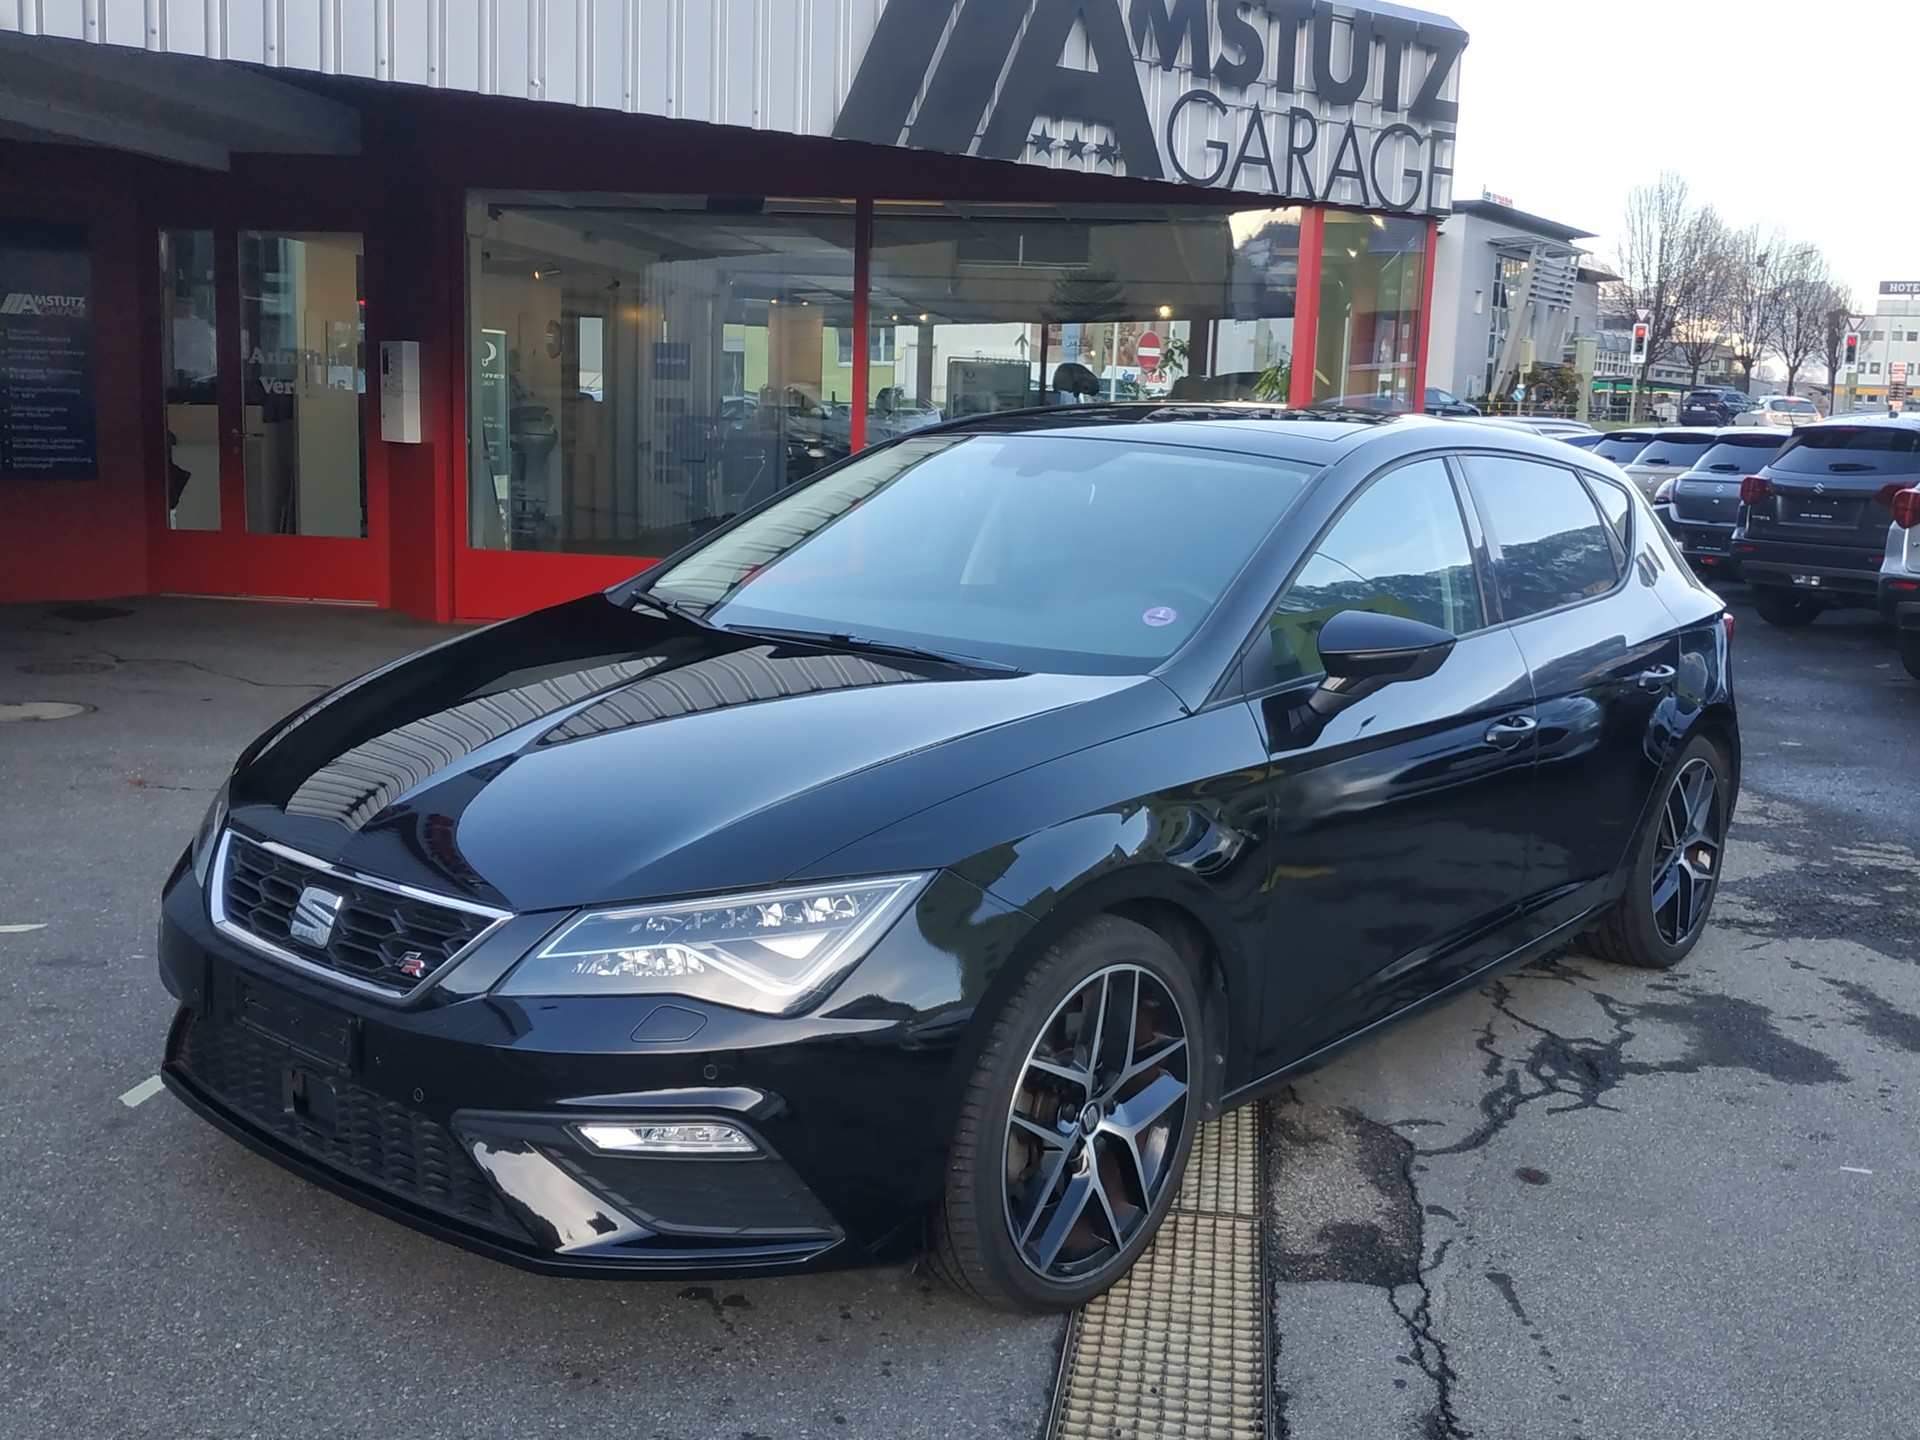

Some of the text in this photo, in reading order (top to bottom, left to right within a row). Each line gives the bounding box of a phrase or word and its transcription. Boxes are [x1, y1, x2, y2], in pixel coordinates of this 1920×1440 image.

[976, 0, 1468, 180] AMSTUTZ
[1166, 89, 1456, 214] GARAGE
[13, 293, 86, 315] AMSTUTZ
[1135, 373, 1167, 384] JMBO
[394, 950, 425, 978] FR
